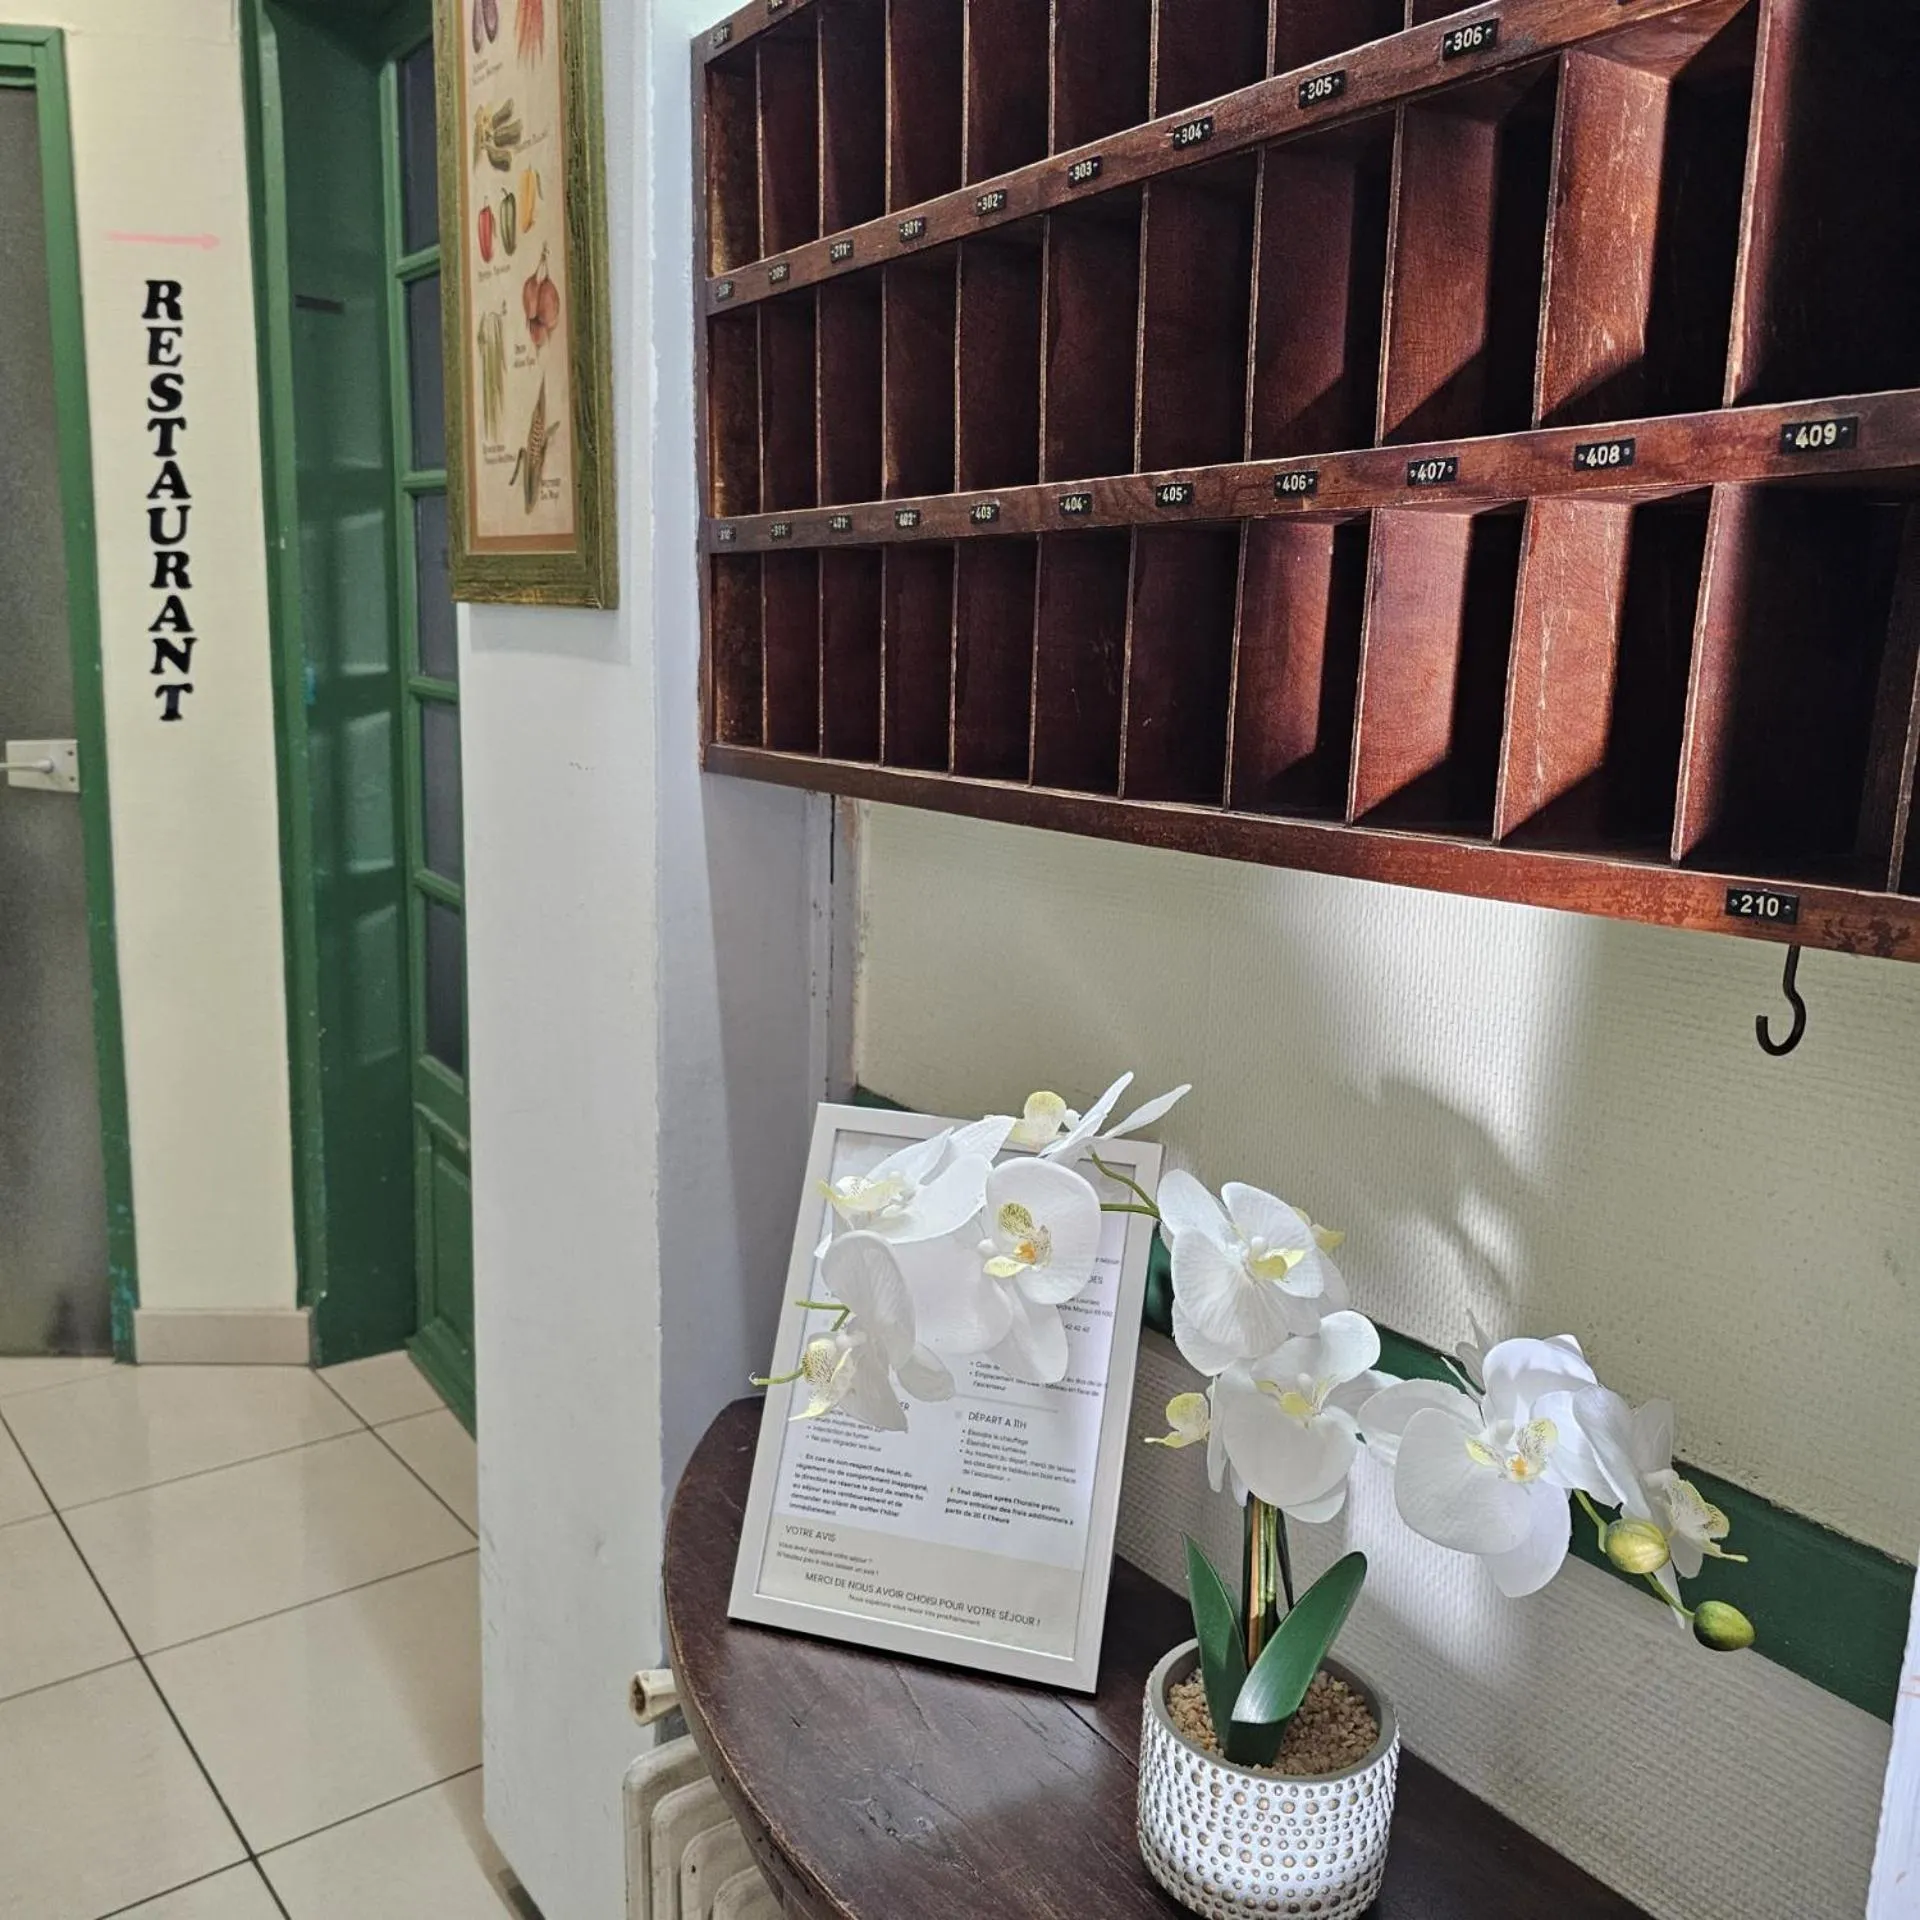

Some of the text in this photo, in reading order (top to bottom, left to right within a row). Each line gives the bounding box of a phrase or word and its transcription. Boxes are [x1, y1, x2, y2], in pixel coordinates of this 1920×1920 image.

[1453, 26, 1484, 51] 306
[1307, 76, 1332, 98] 305
[1181, 124, 1202, 144] 304
[1073, 162, 1092, 181] 303
[981, 195, 999, 210] 302
[903, 220, 919, 235] 301
[834, 243, 847, 258] 211
[1795, 423, 1837, 448] 409
[1585, 444, 1621, 467] 408
[1417, 461, 1446, 481] 407
[1282, 475, 1307, 493] 406
[142, 280, 197, 721] RESTAURANT
[1162, 487, 1183, 503] 405
[975, 506, 993, 520] 403
[1065, 497, 1083, 512] 404
[833, 516, 847, 529] 401
[899, 513, 914, 527] 402
[1740, 894, 1779, 917] 210
[968, 1411, 1003, 1425] DÉPART
[785, 1524, 837, 1542] VOTRE AVIS
[806, 1572, 833, 1585] MERCI
[834, 1577, 845, 1588] DE
[847, 1580, 875, 1594] NOUS
[876, 1586, 905, 1599] AVOIR
[906, 1591, 937, 1606] CHOISI
[939, 1598, 965, 1611] POUR
[968, 1603, 997, 1617] VOTRE
[998, 1610, 1035, 1625] SÉJOUR
